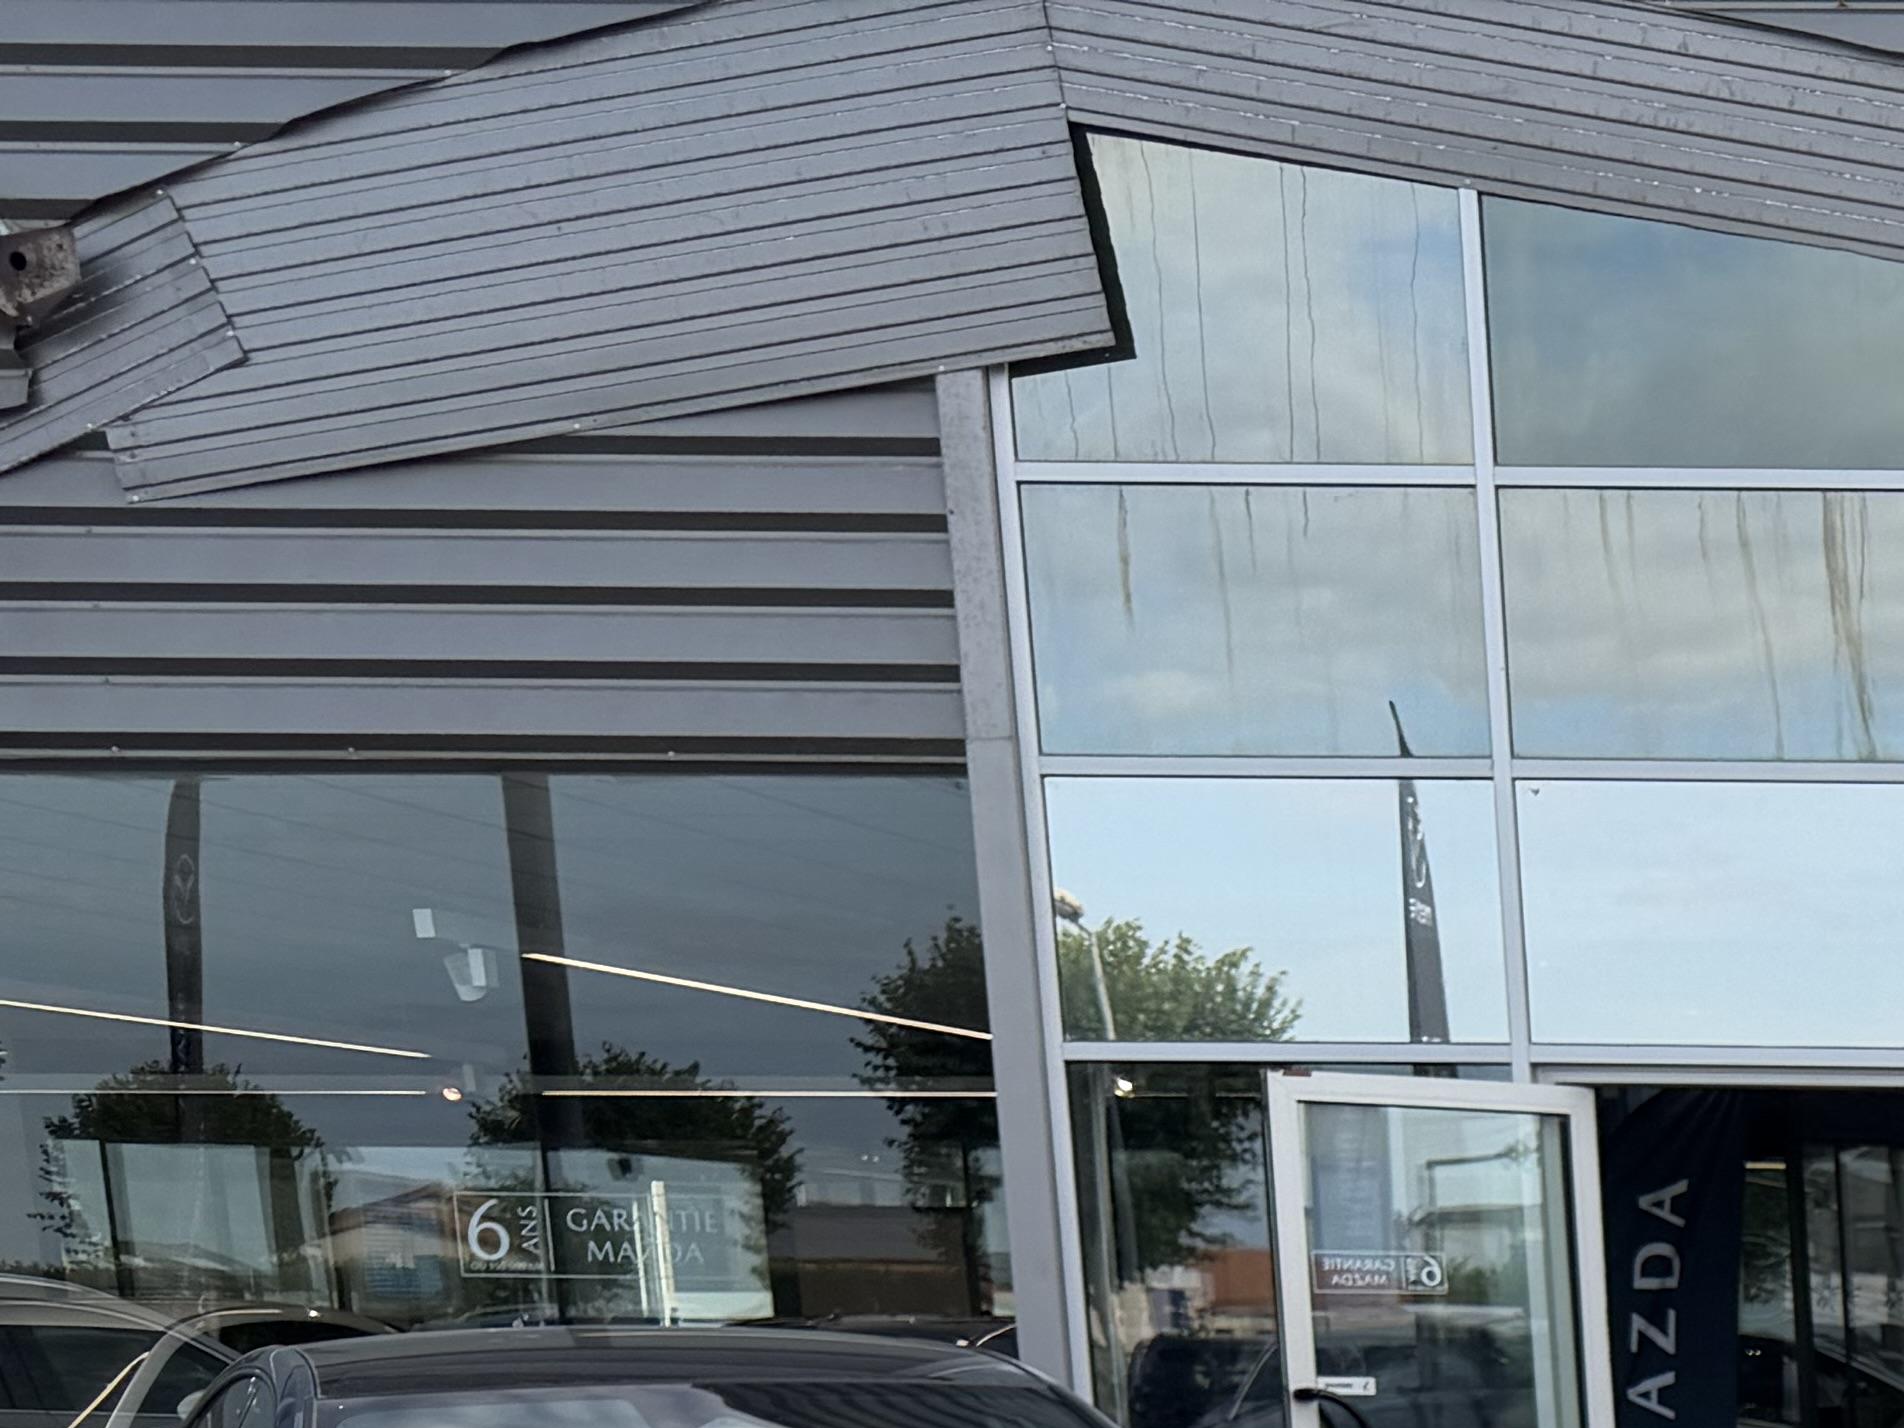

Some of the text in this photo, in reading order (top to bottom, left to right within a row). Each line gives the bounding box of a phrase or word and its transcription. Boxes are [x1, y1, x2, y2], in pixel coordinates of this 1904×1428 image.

[467, 1198, 511, 1261] 6
[519, 1205, 539, 1254] ANS
[566, 1207, 719, 1233] GARTIE
[587, 1240, 705, 1265] MADA
